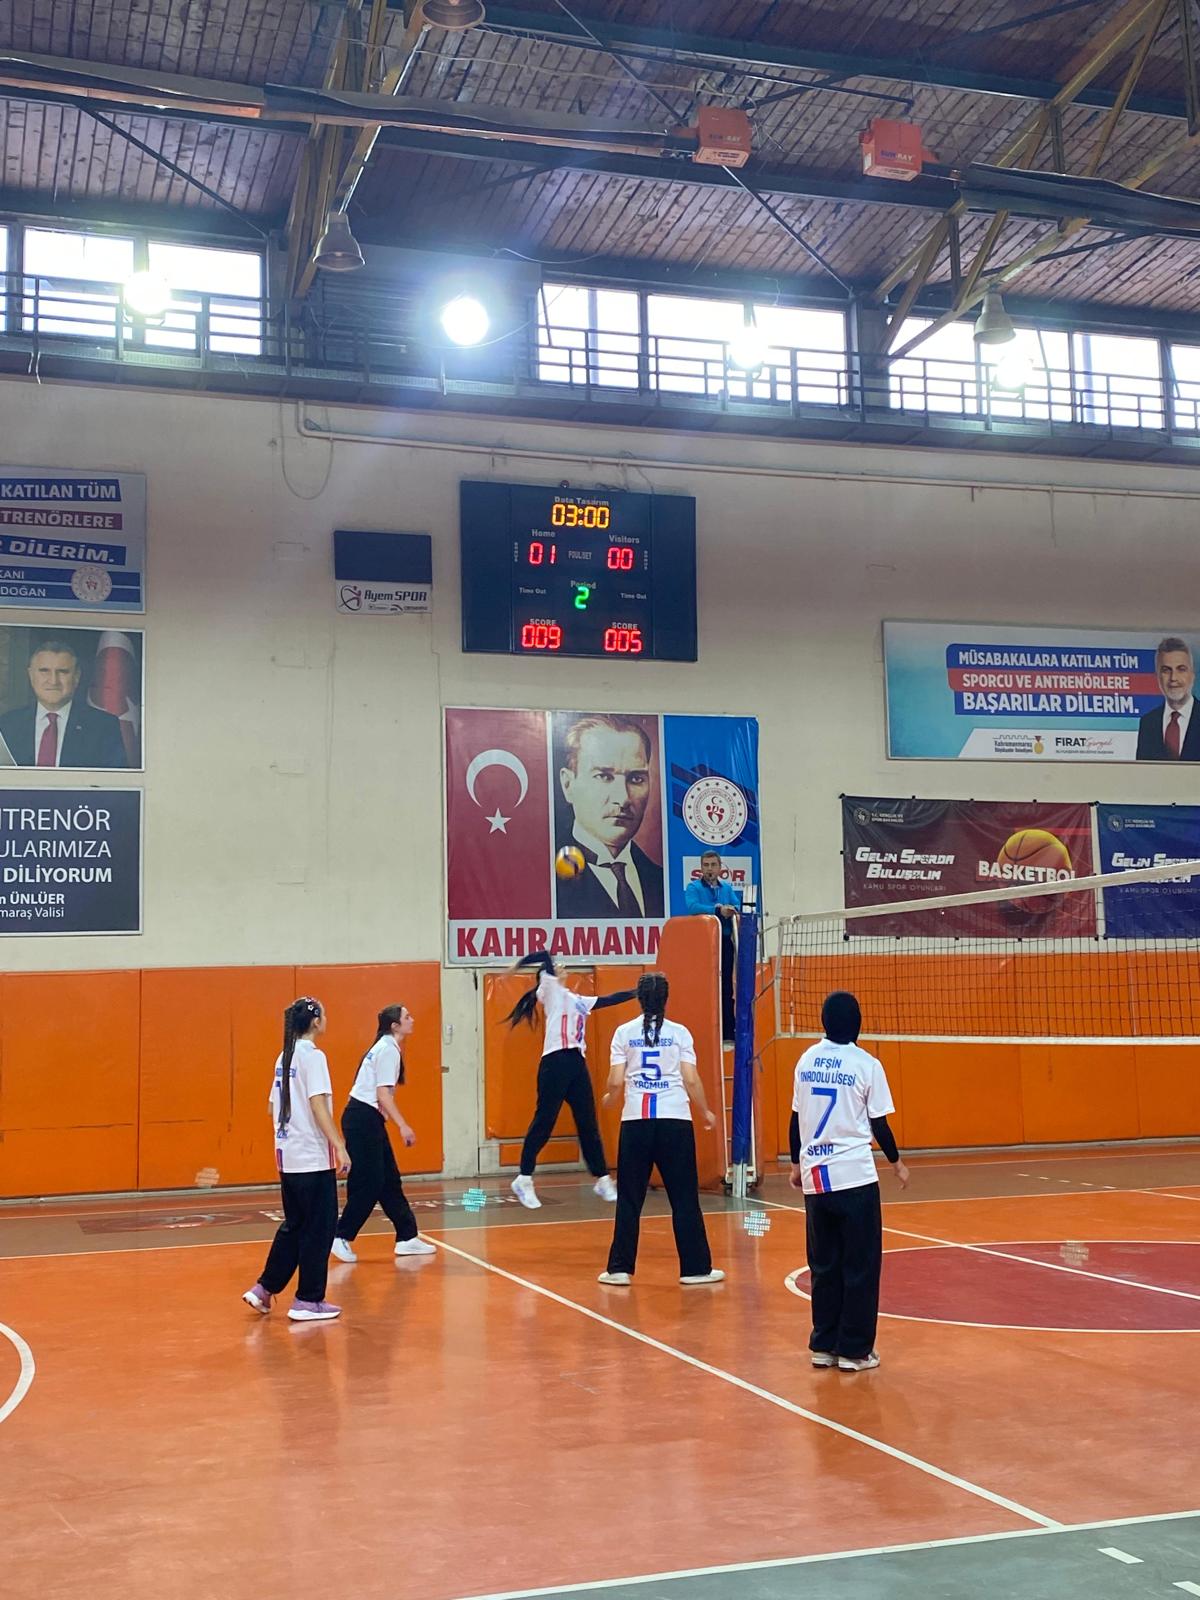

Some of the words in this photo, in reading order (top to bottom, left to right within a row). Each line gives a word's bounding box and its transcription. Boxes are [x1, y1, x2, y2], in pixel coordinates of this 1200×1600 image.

[1, 484, 73, 498] KATILAN
[77, 482, 116, 499] TÜM
[1, 510, 114, 528] TRENÖRLERE
[552, 503, 610, 528] 03:00
[531, 529, 556, 537] Home
[609, 535, 640, 544] Visitors
[9, 540, 115, 563] DİLERİM.
[529, 542, 556, 565] 01
[607, 547, 634, 570] 00
[0, 586, 46, 597] DOĞAN
[574, 586, 590, 610] 2
[529, 618, 557, 626] SCORE
[612, 622, 638, 630] SCORE
[521, 625, 561, 649] 009
[604, 628, 642, 652] 005
[959, 650, 1059, 668] MÜSABAKALARA
[1061, 654, 1111, 668] KATILAN
[1113, 653, 1139, 669] TÜM
[962, 673, 1013, 688] SPORCU
[1016, 675, 1032, 688] VE
[1034, 672, 1130, 690] ANTRENÖRLERE
[963, 691, 1063, 714] BAŞARILAR
[1065, 692, 1140, 714] DİLERİM.
[1055, 737, 1087, 747] FIRAT
[0, 805, 111, 831] TRENÖR
[3, 864, 112, 883] DİLİYORUM
[691, 869, 746, 882] SOR
[9, 890, 65, 905] ÜNLÜER
[34, 906, 64, 918] Valisi
[640, 1050, 662, 1081] 5
[813, 1056, 843, 1070] AFŞİN
[831, 1070, 857, 1087] LİSESİ
[811, 1086, 838, 1139] 7
[807, 1143, 834, 1157] SENA
